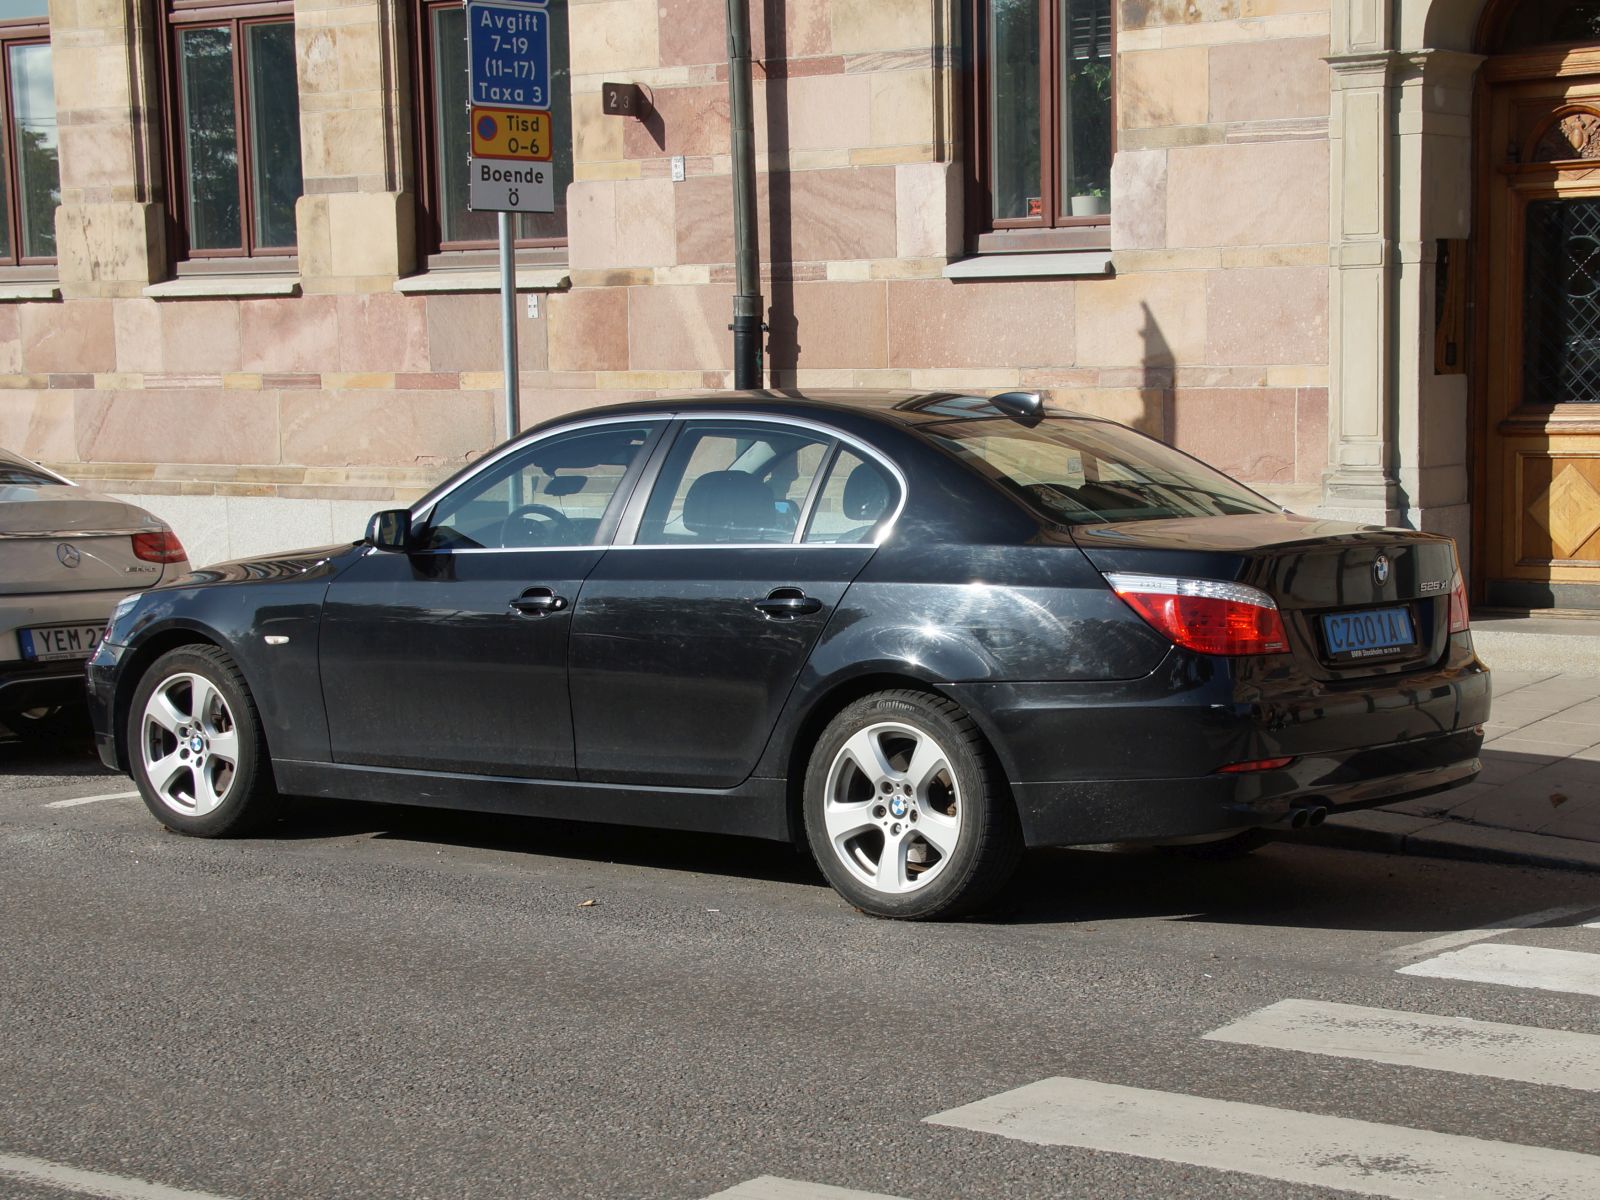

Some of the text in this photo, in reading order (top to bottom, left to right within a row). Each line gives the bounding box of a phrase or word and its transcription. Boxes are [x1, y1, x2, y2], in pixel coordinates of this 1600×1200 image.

[480, 10, 538, 33] Avgift
[491, 35, 529, 54] 7-19
[485, 57, 536, 80] (11-17)
[479, 82, 542, 103] Taxa 3
[506, 115, 540, 132] Tisd
[508, 137, 540, 154] 0-6
[481, 165, 544, 184] Boende
[508, 188, 519, 206] Ö
[39, 628, 82, 652] YEM
